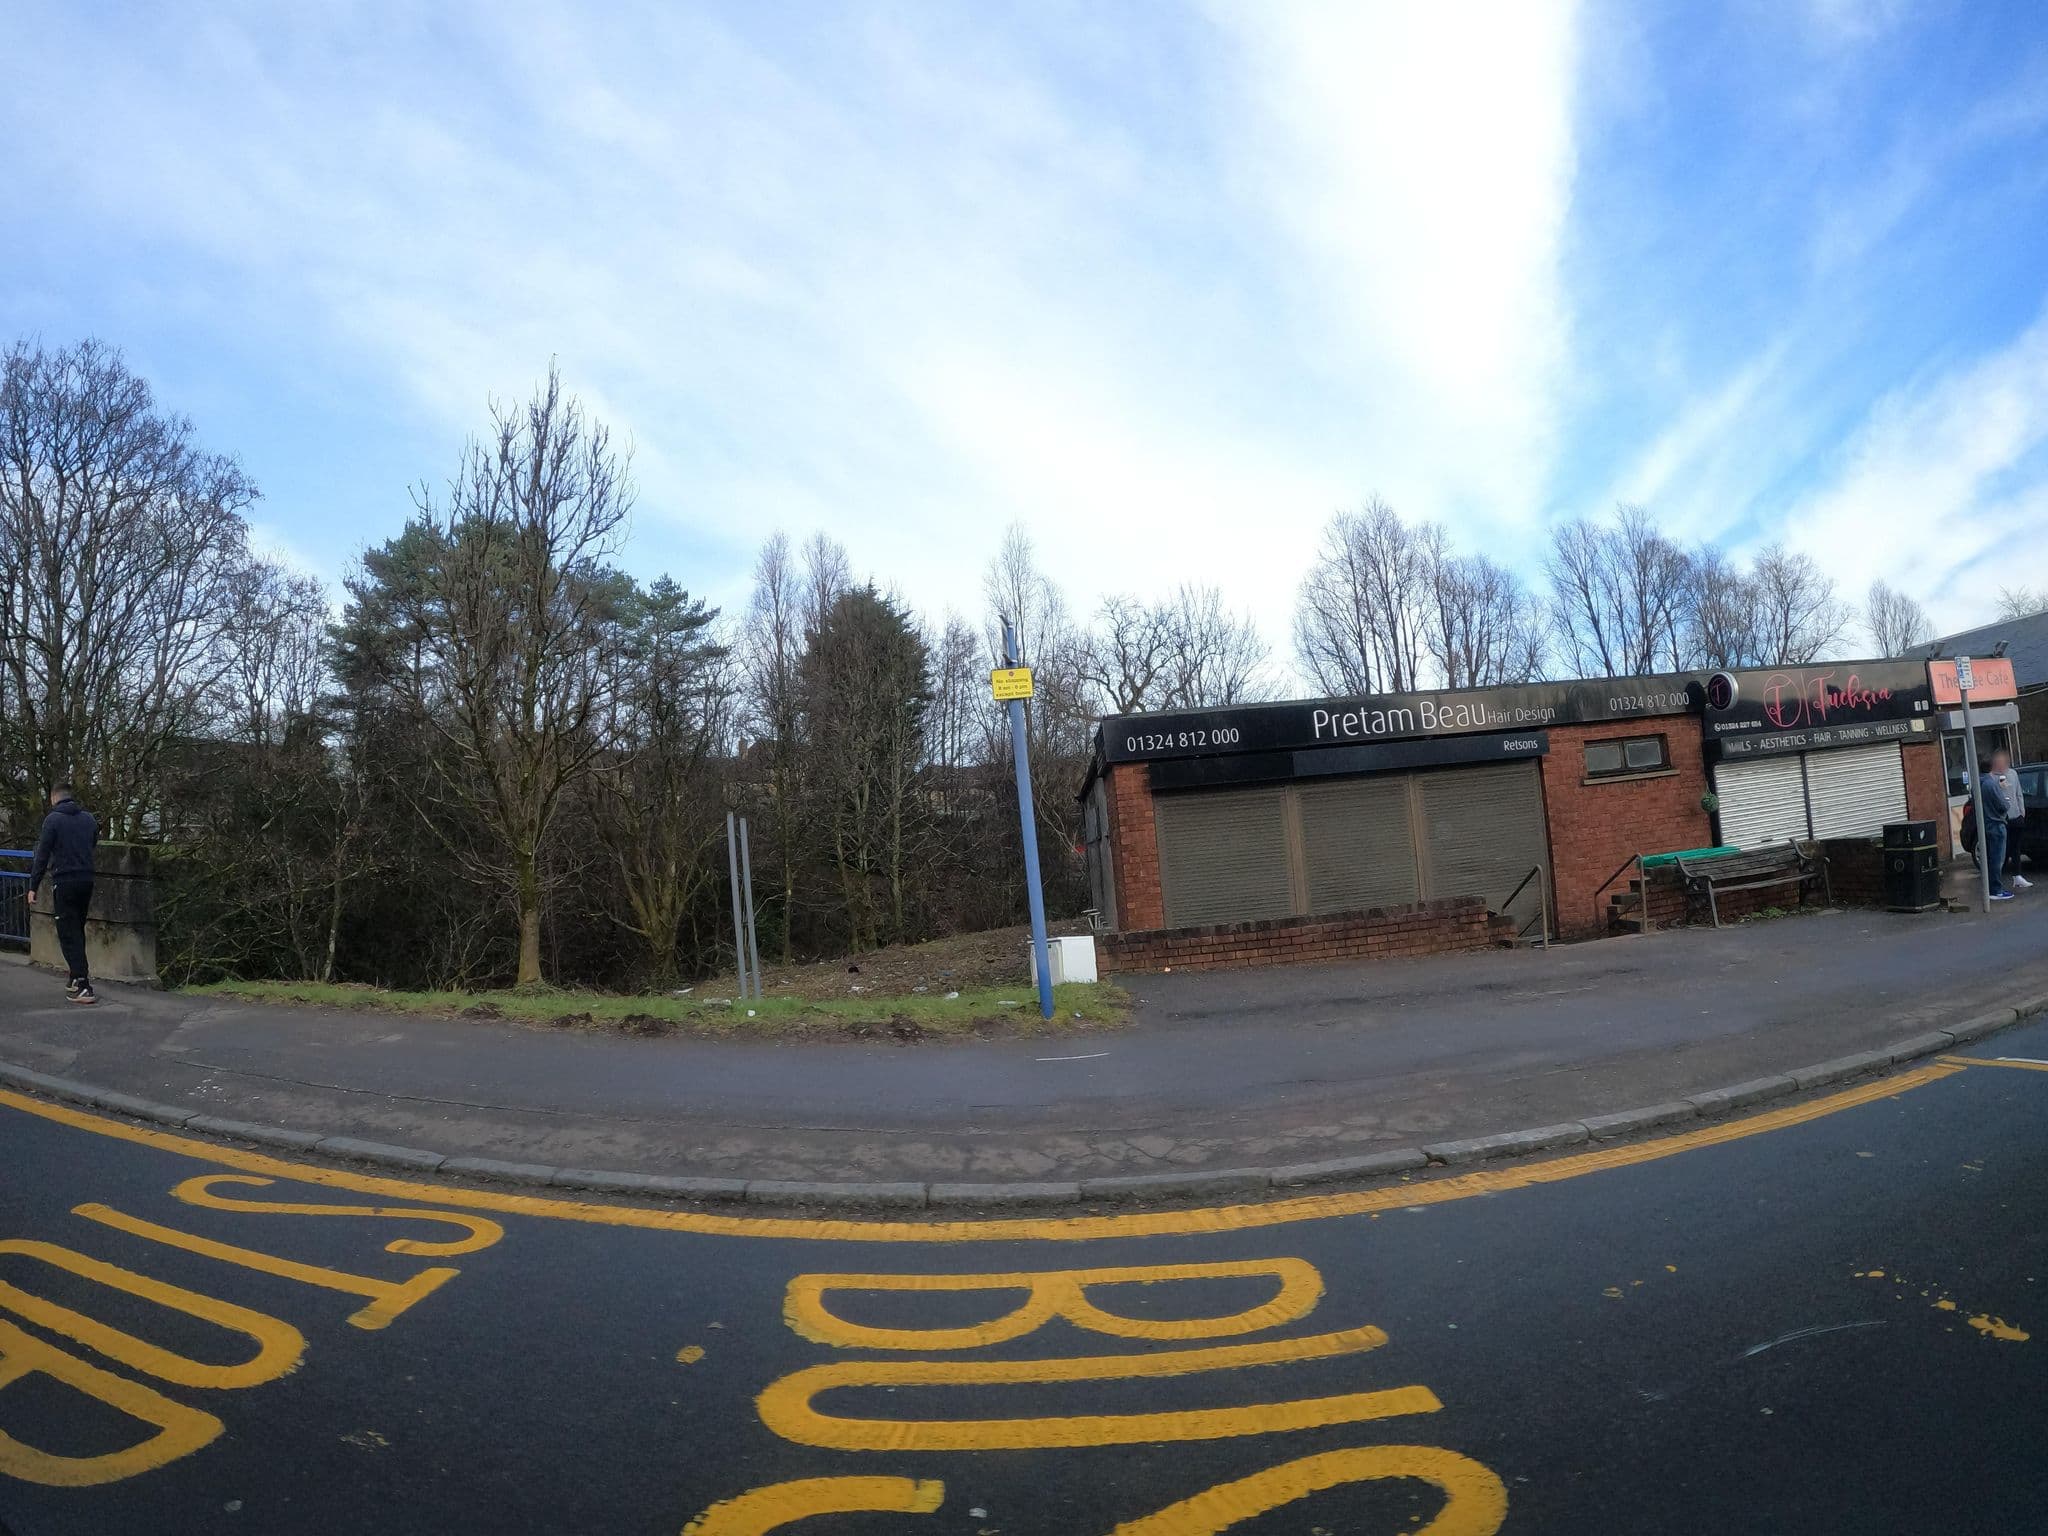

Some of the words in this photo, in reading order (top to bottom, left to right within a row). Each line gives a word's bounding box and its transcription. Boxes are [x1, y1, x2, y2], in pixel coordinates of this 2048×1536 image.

[1609, 696, 1644, 711] 01324
[1648, 693, 1667, 708] 812
[1670, 691, 1690, 706] 000
[1313, 706, 1415, 739] Pretam
[1420, 701, 1486, 730] Beau
[1487, 707, 1511, 724] Hair
[1516, 706, 1556, 724] Design
[1127, 733, 1174, 752] 01324
[1179, 730, 1207, 747] 812
[1211, 728, 1240, 745] 000
[1760, 734, 1807, 750] AESTHETICS
[1814, 731, 1832, 743] HAIR
[1839, 727, 1869, 740] TANNING
[1875, 722, 1909, 736] WELLNESS
